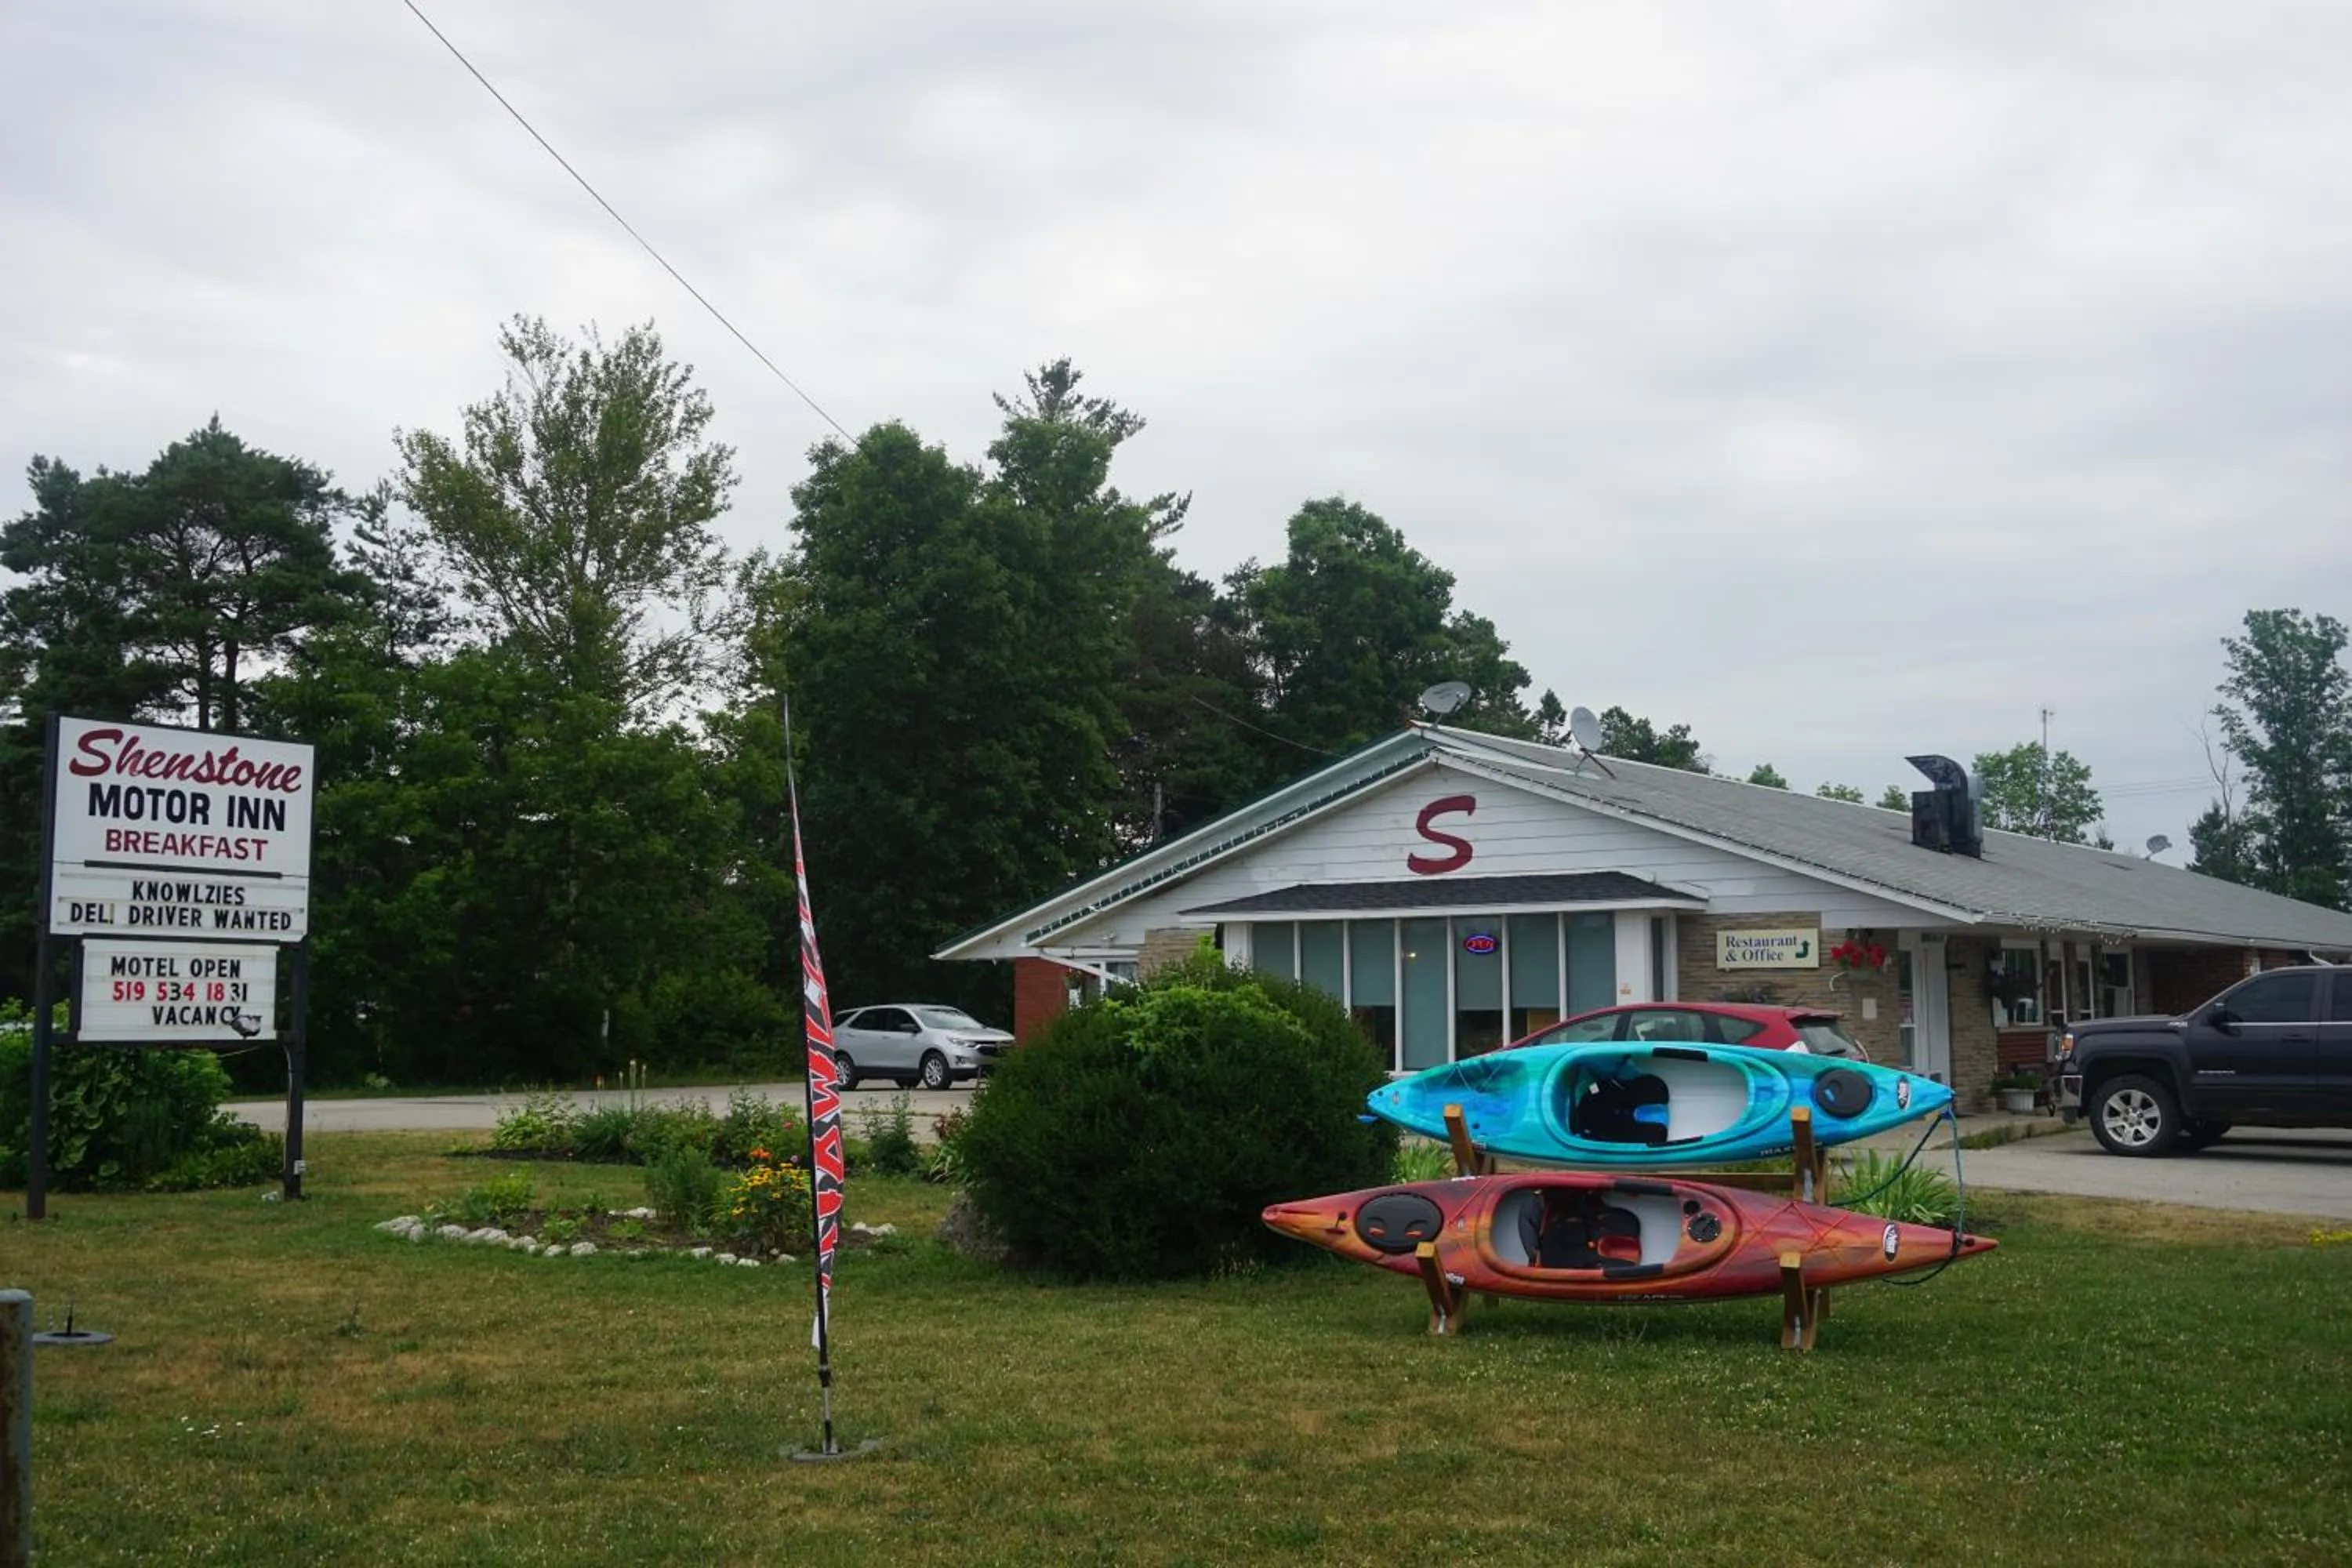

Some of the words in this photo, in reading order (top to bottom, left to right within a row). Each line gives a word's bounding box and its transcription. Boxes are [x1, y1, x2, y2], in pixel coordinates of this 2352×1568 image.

[69, 729, 303, 793] Shenstone
[89, 782, 211, 826] MOTOR
[227, 795, 287, 832] INN
[106, 829, 268, 861] BREAKFAST
[1406, 795, 1476, 875] S
[132, 880, 245, 906] KNOWLZIES
[129, 905, 202, 927] DRIVER
[214, 909, 292, 931] WANTED
[1726, 935, 1797, 948] Restaurant
[111, 956, 180, 977] MOTEL
[190, 958, 241, 978] OPEN
[1725, 949, 1737, 962] &
[1741, 949, 1784, 962] Office
[112, 981, 146, 1002] 519
[157, 982, 194, 1002] 534
